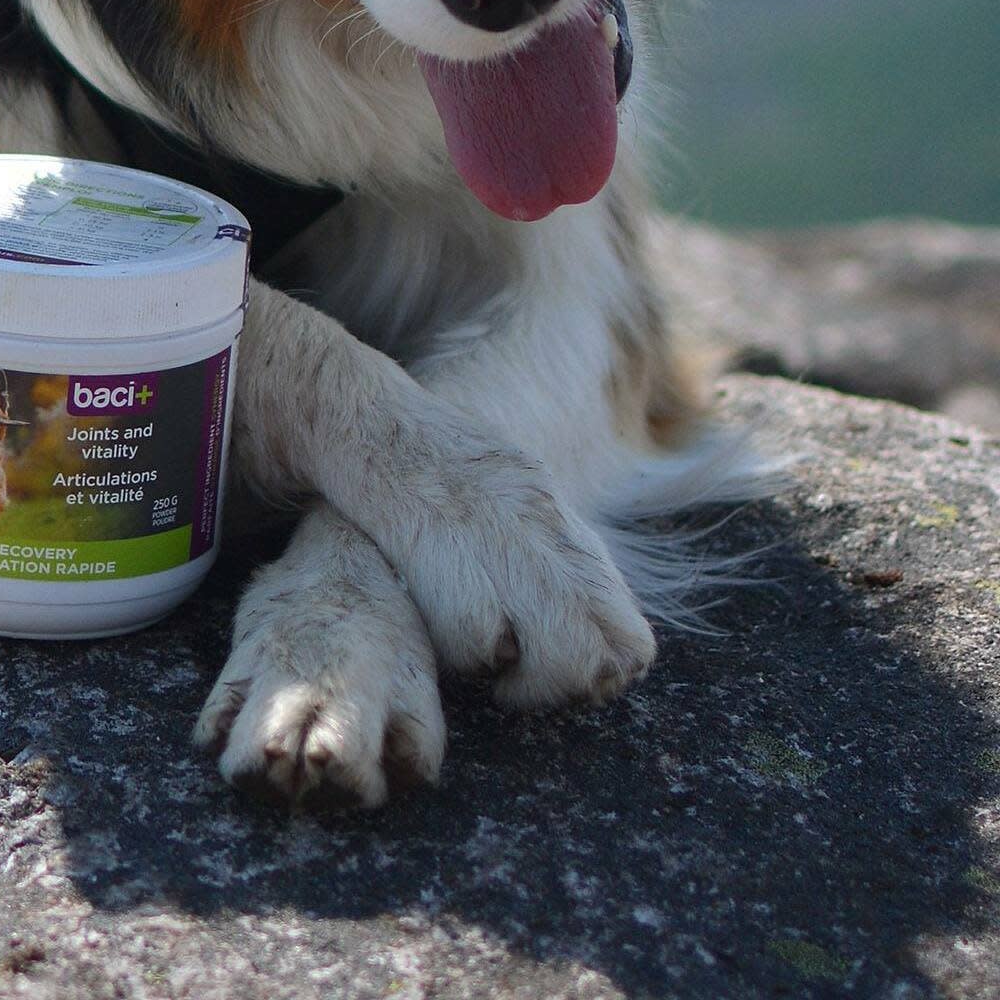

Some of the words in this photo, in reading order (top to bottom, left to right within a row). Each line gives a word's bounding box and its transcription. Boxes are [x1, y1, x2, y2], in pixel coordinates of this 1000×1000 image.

[67, 427, 119, 442] Joints
[123, 423, 153, 438] and
[81, 444, 139, 460] vitality
[52, 470, 158, 487] Articulations
[66, 491, 84, 505] et
[89, 486, 144, 505] vitalité
[153, 497, 170, 511] 250
[152, 507, 177, 519] POWDER
[152, 515, 176, 526] POUDRE
[56, 561, 117, 575] RAPIDE
